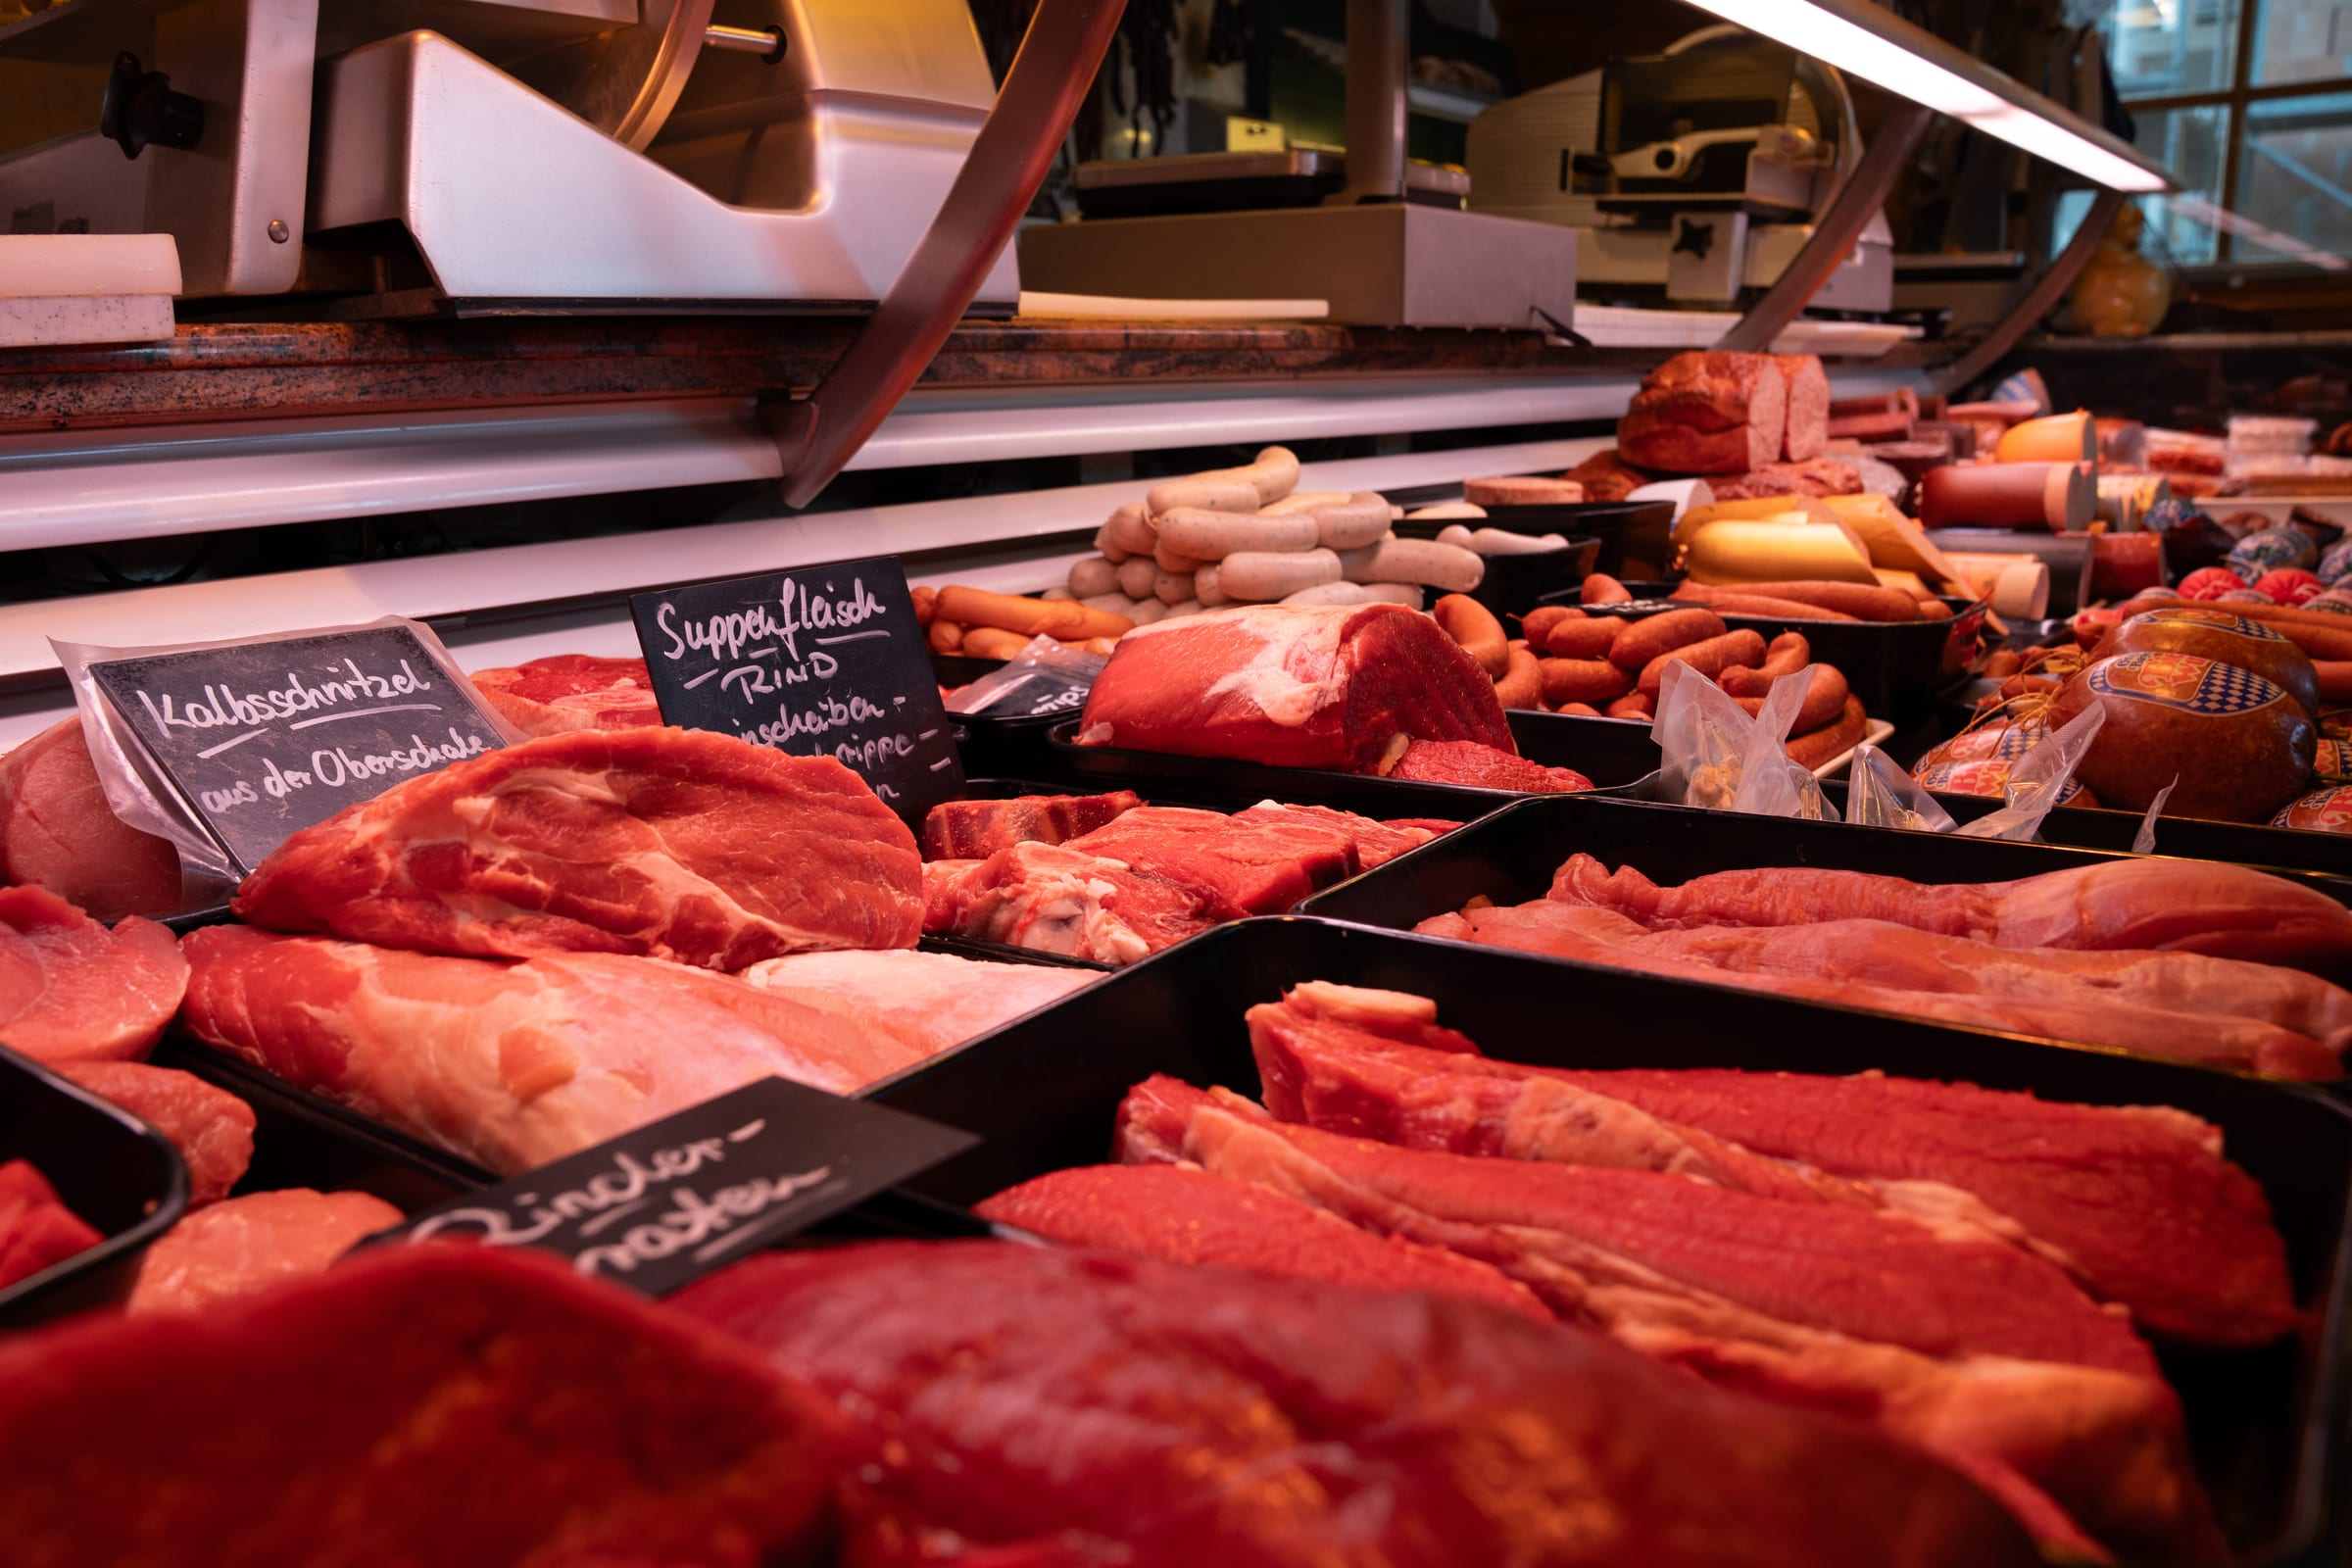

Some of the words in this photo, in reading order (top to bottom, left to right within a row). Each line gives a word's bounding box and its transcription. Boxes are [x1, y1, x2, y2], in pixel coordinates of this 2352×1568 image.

[656, 576, 887, 662] Suppenfleisch
[136, 658, 432, 739] Kalbsschnitzel
[201, 780, 259, 814] aus
[263, 759, 313, 798] der
[312, 727, 492, 787] Oberschale
